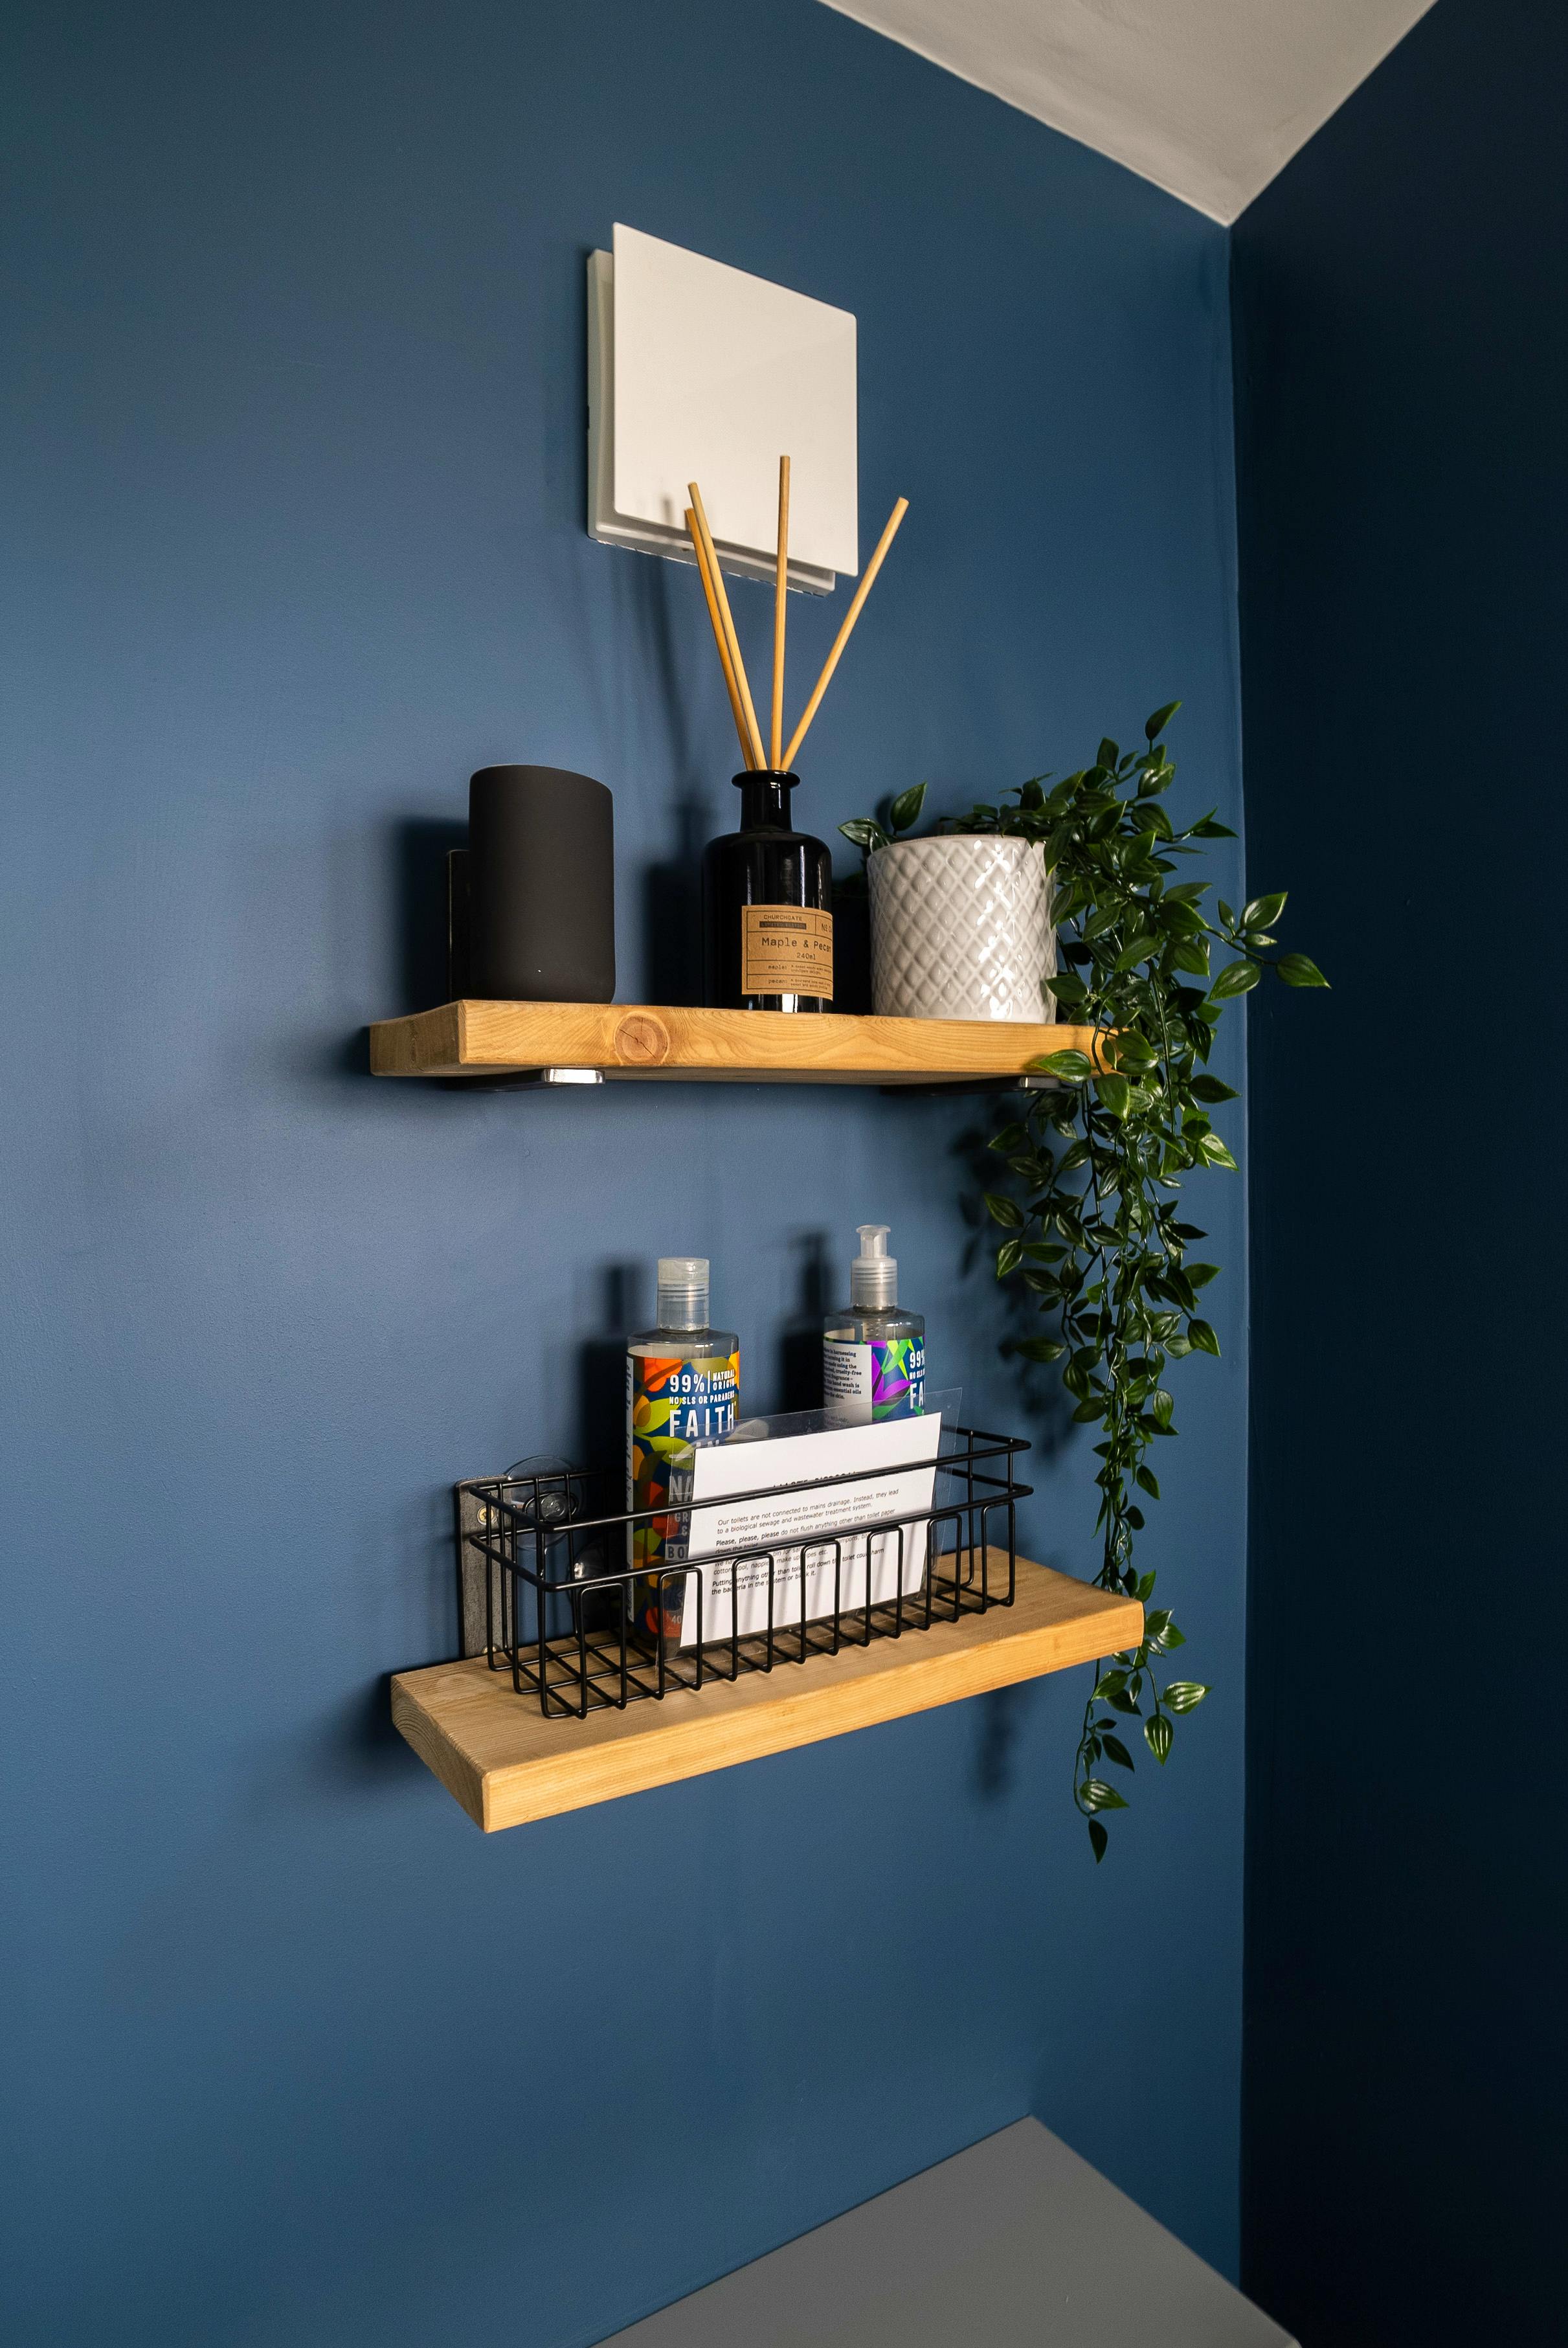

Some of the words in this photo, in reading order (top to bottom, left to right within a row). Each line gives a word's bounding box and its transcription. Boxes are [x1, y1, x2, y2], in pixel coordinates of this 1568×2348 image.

[762, 937, 798, 948] Maple
[803, 940, 809, 948] &
[669, 1374, 704, 1393] 99%
[713, 1370, 735, 1381] NATURAL
[669, 1397, 679, 1405] NO
[699, 1396, 708, 1405] OR
[710, 1390, 735, 1403] PARABENS
[669, 1403, 734, 1438] FAITH
[772, 1507, 801, 1517] connected
[809, 1503, 825, 1511] mains
[827, 1498, 851, 1508] drainage.
[853, 1494, 874, 1503] Instead,
[876, 1491, 887, 1499] they
[731, 1522, 757, 1533] biological
[759, 1520, 780, 1528] sewage
[794, 1511, 823, 1521] wastewater
[825, 1506, 851, 1516] treatment
[852, 1502, 873, 1511] system.
[739, 1535, 759, 1544] please,
[761, 1530, 779, 1540] please
[814, 1518, 838, 1530] anything
[854, 1513, 866, 1522] than
[880, 1508, 895, 1517] paper
[737, 1574, 759, 1583] nything
[816, 1559, 831, 1567] down
[842, 1553, 855, 1562] toilet
[871, 1547, 884, 1555] harm
